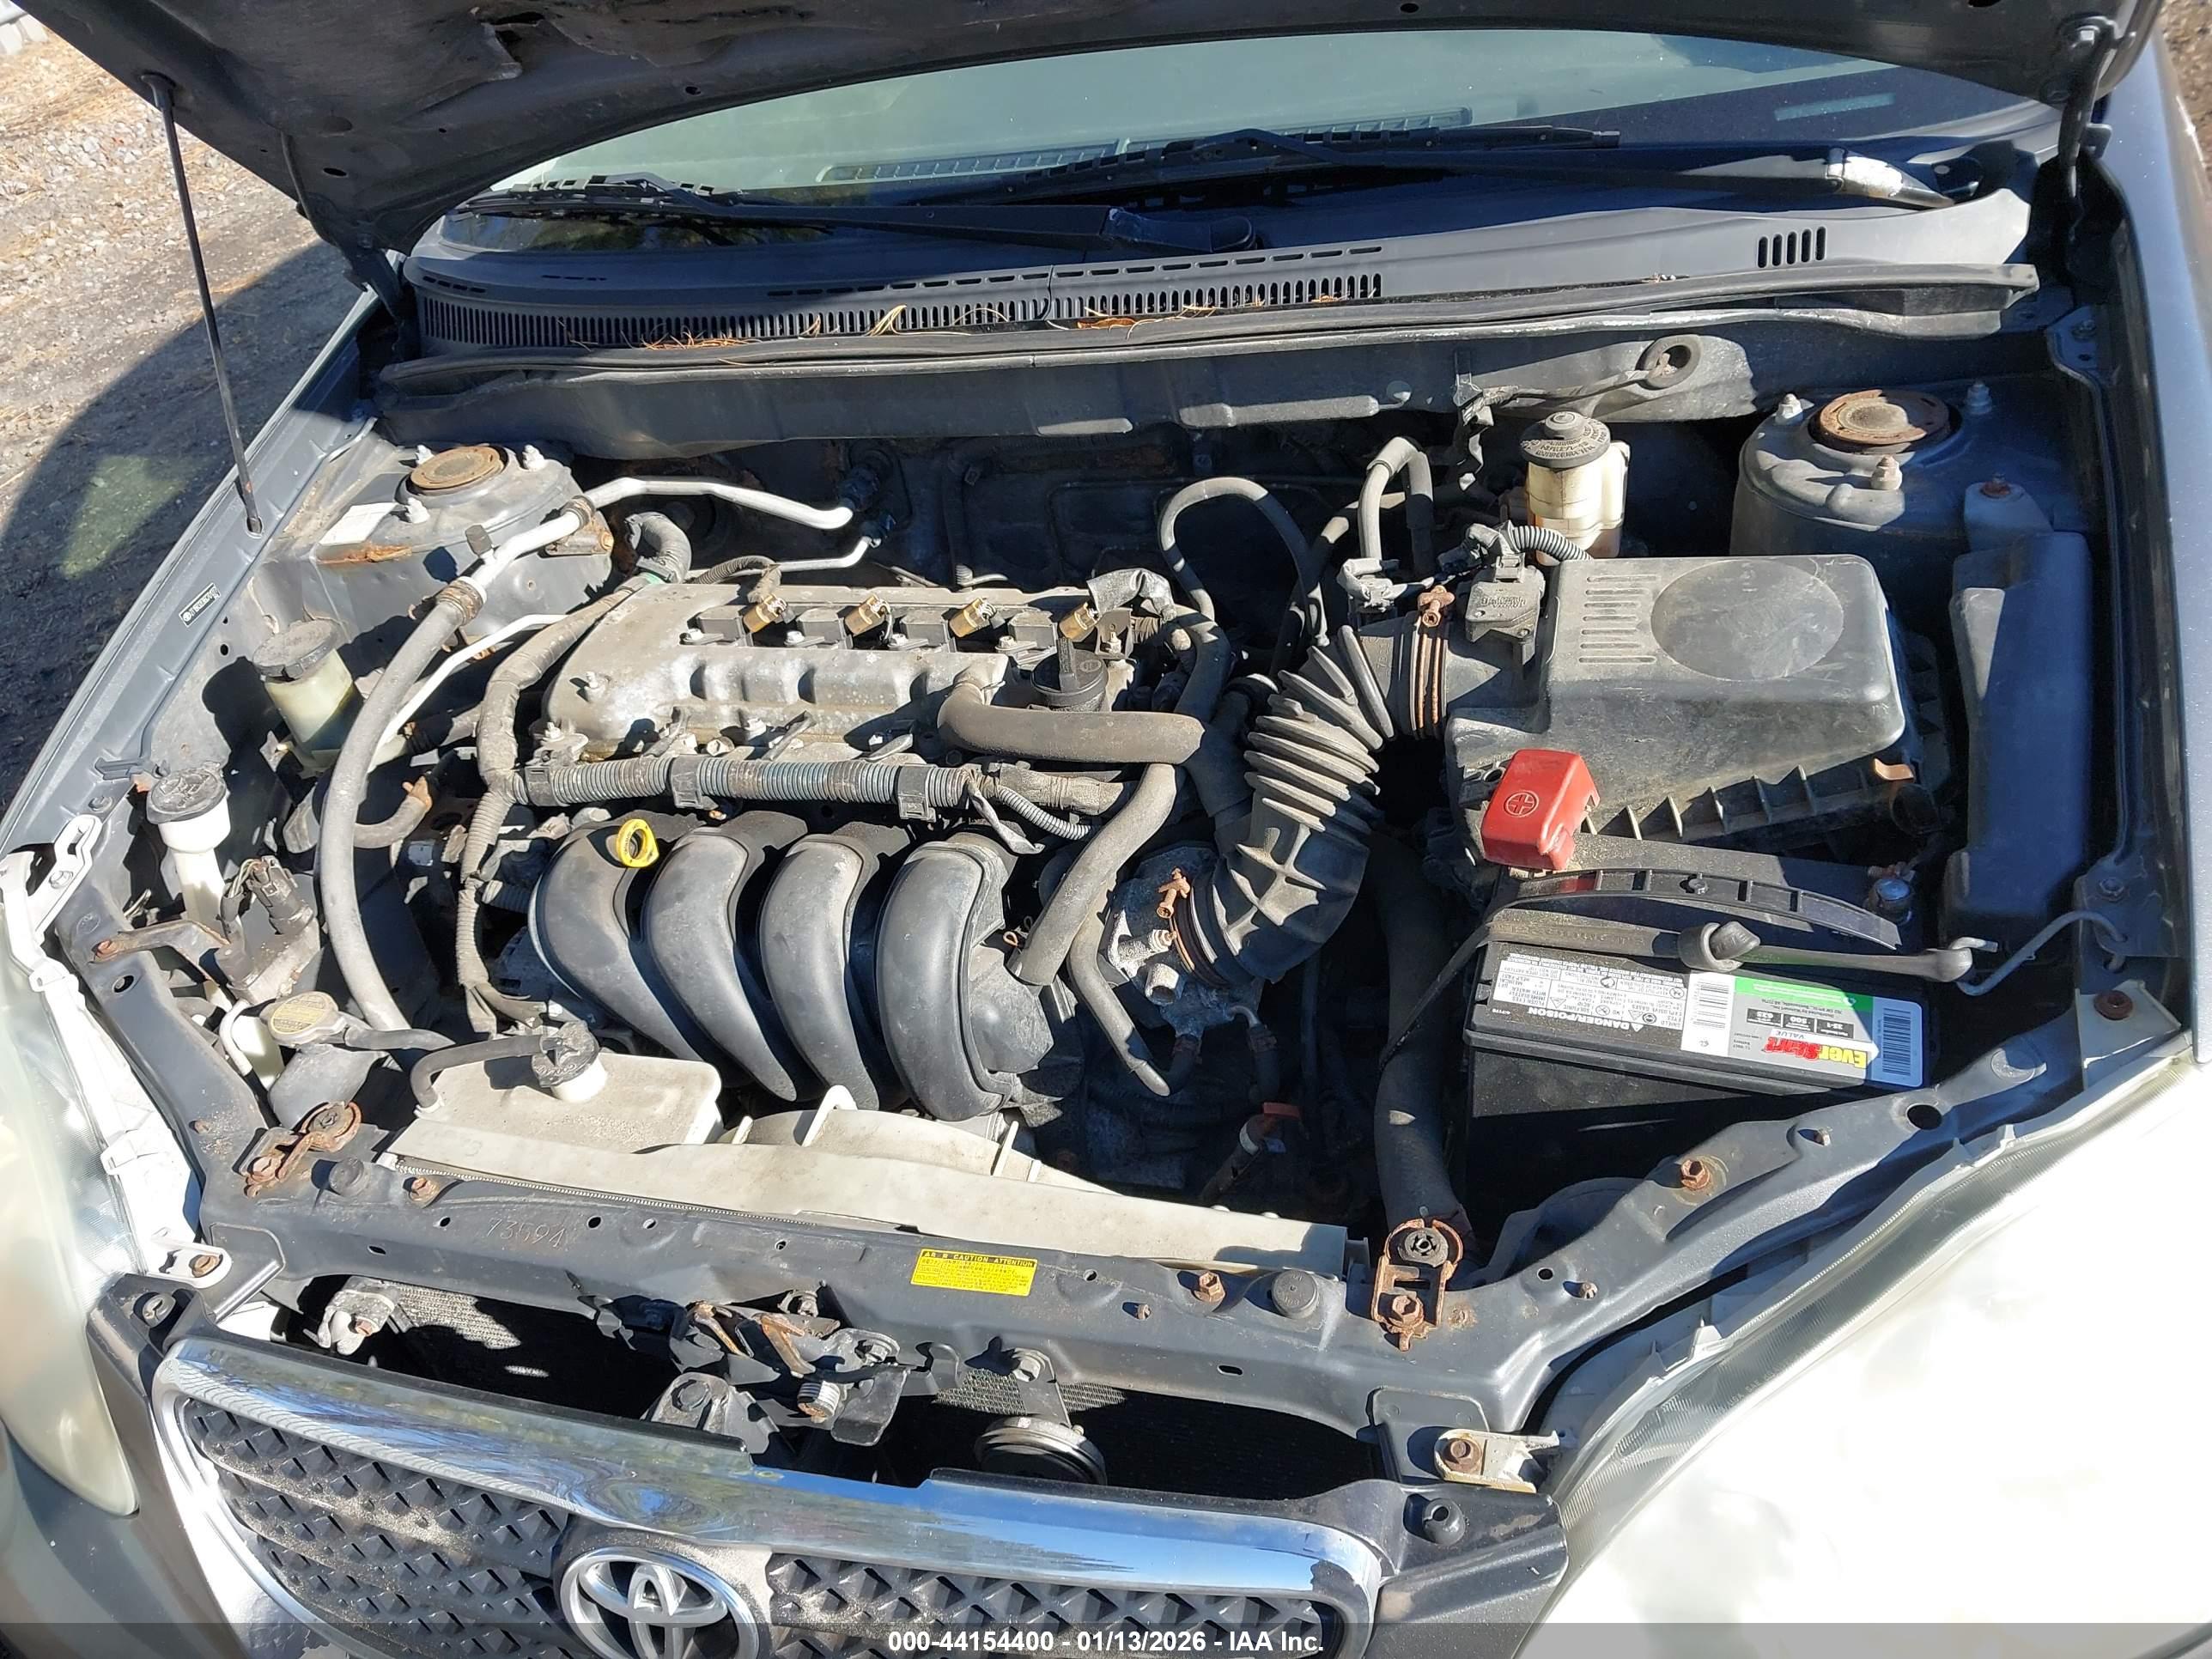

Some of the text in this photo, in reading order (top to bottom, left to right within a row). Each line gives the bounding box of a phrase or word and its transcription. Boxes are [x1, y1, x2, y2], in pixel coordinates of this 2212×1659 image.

[1527, 1006, 1629, 1030] DANGER/POISON
[1775, 1030, 1804, 1039] VALUE
[1764, 1036, 1868, 1068] EverStart
[953, 1254, 989, 1262] CAUTION
